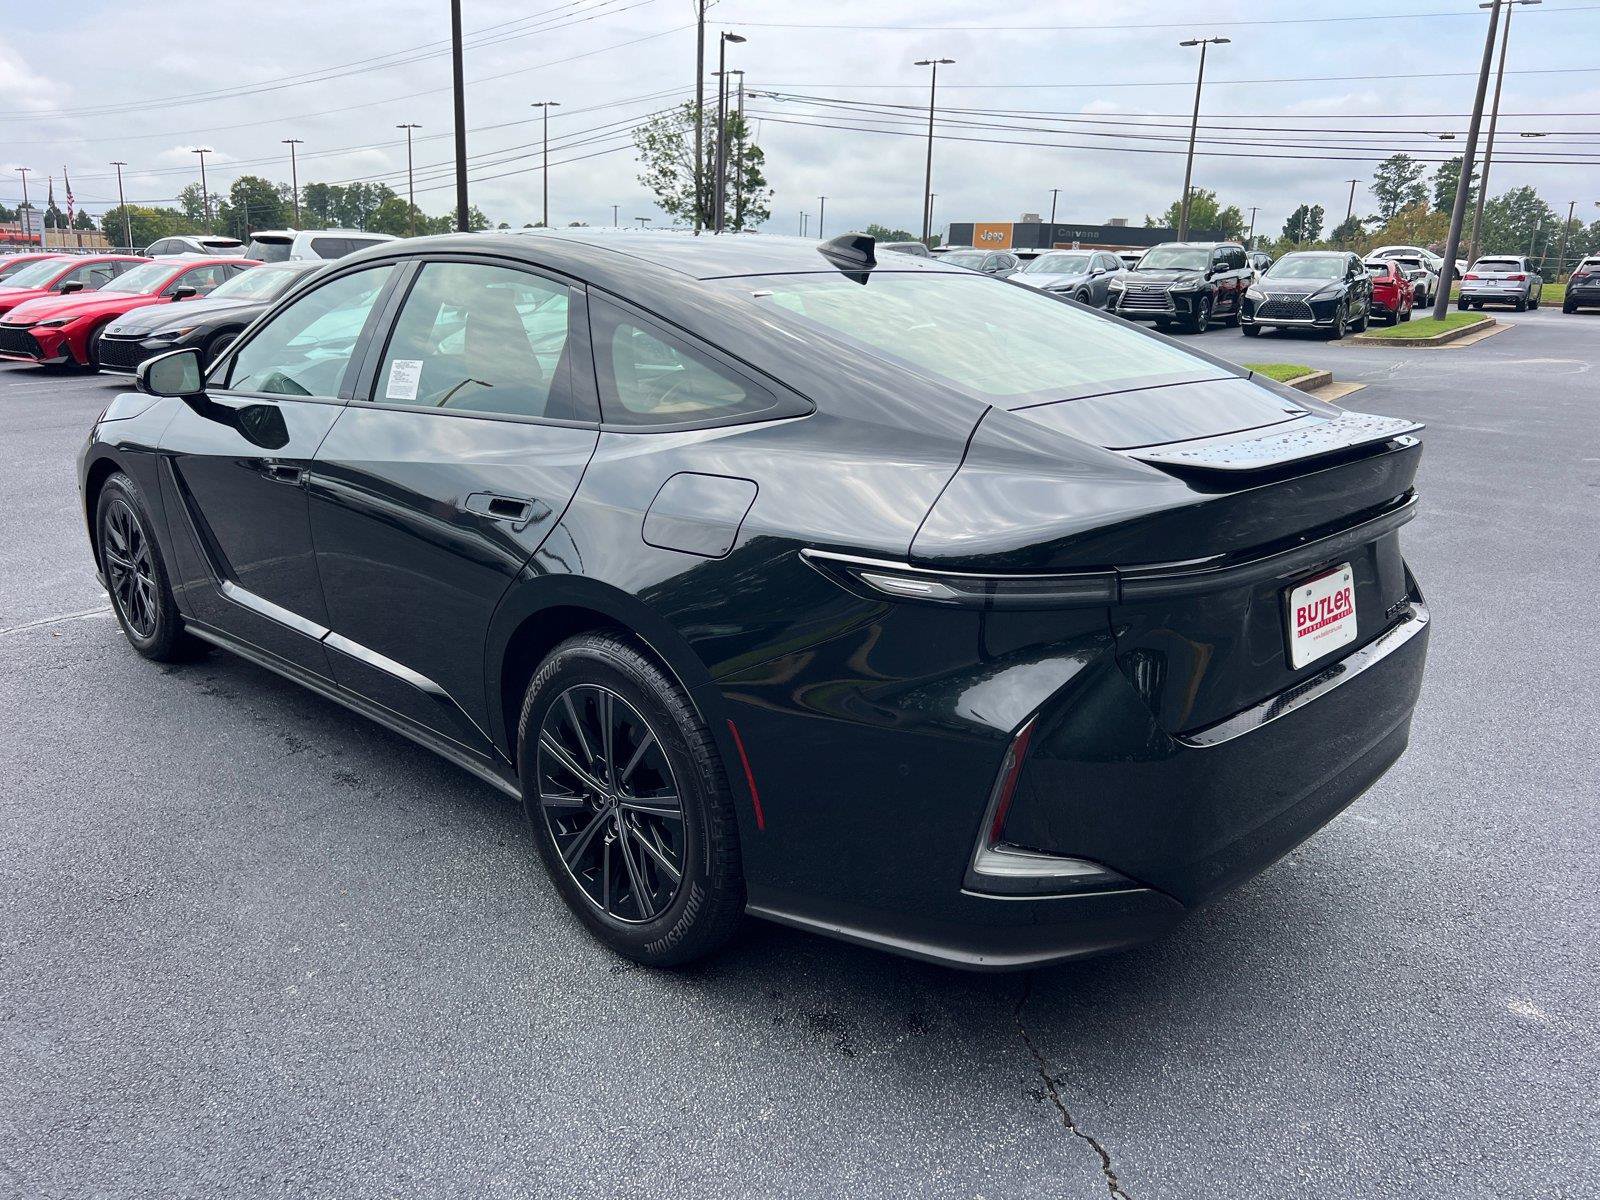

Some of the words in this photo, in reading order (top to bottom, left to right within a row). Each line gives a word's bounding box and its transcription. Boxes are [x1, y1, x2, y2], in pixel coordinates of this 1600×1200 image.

[981, 229, 1004, 243] Jeep
[1057, 228, 1100, 239] Carvana
[518, 656, 562, 740] BRIDGESTONE
[643, 880, 706, 956] BRIDGESTONE
